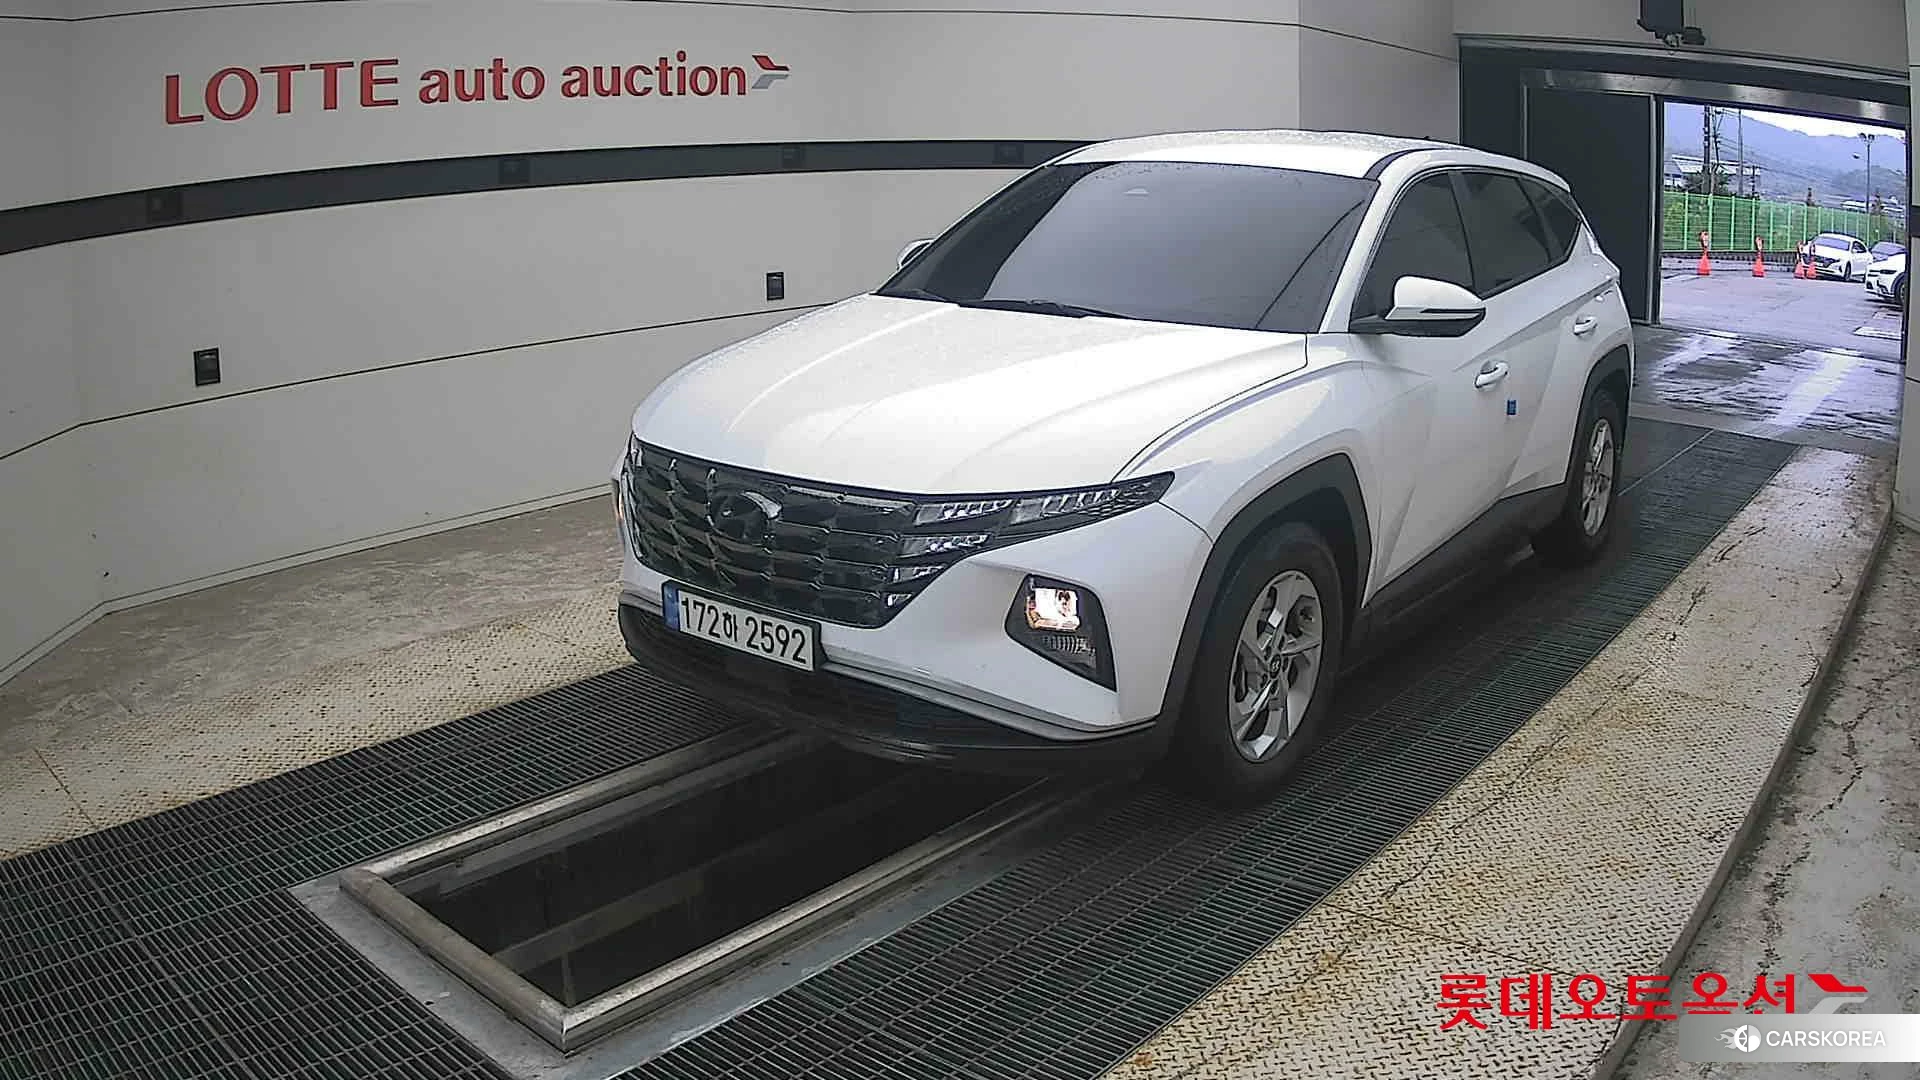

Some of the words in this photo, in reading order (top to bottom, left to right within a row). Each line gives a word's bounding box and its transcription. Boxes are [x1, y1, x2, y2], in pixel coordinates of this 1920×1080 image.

[165, 58, 400, 125] LOTTE
[418, 57, 546, 104] auto
[561, 50, 748, 98] auction
[681, 597, 738, 642] 172하
[745, 616, 807, 664] 2592
